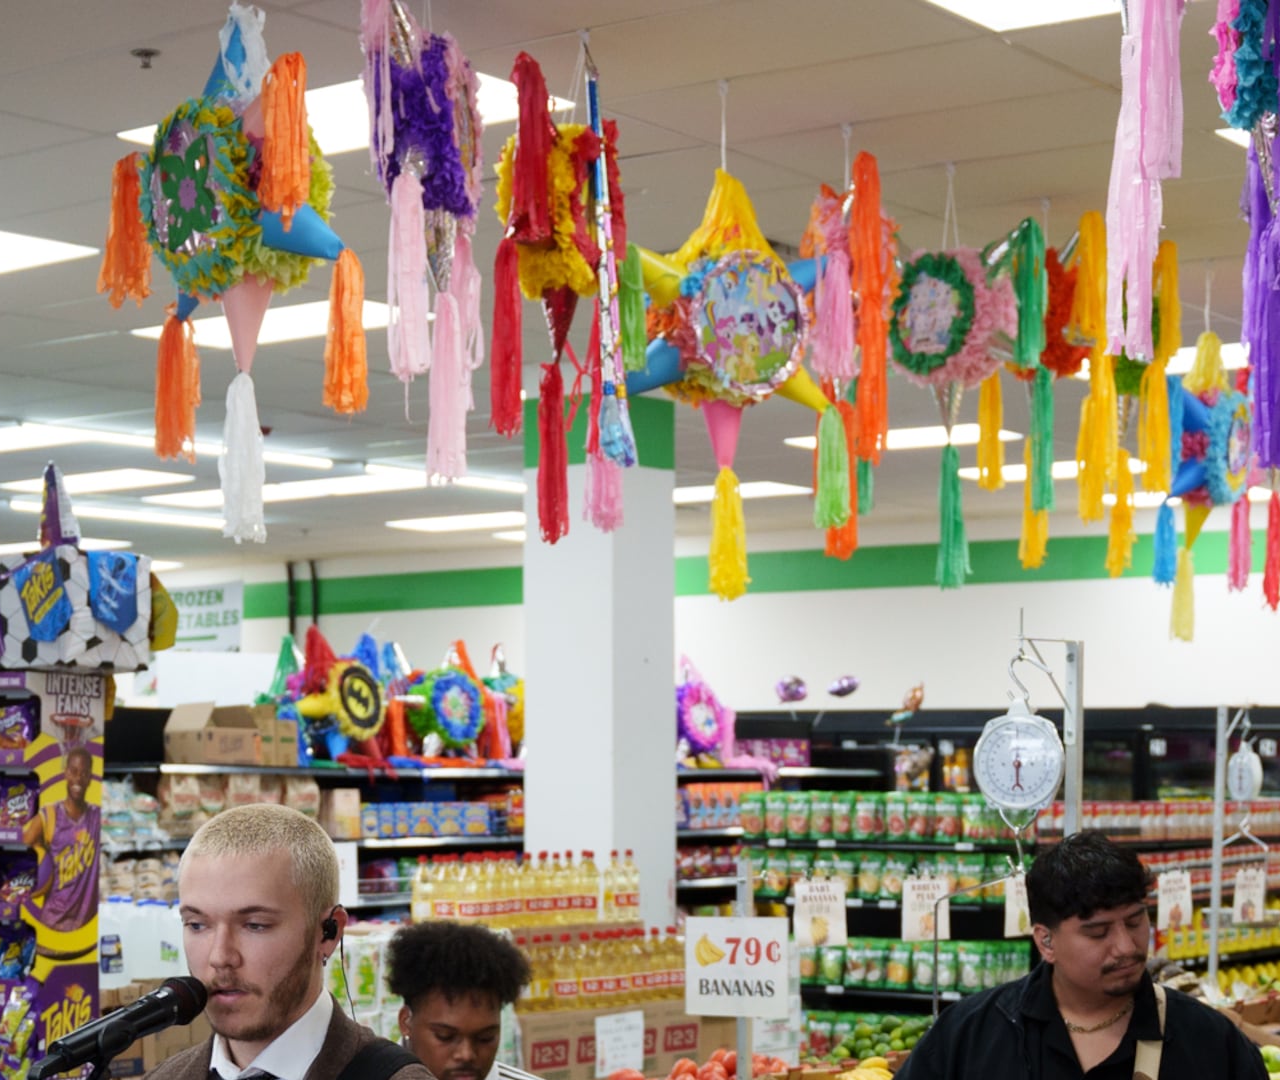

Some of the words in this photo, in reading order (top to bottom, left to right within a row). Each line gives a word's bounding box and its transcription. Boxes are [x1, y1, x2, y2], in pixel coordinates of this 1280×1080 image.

[21, 562, 55, 621] Takis
[176, 609, 239, 630] ETABLES
[46, 674, 101, 696] INTENSE
[56, 696, 91, 717] FANS
[724, 936, 781, 966] 79¢
[698, 978, 776, 998] BANANAS
[40, 995, 93, 1051] Takis
